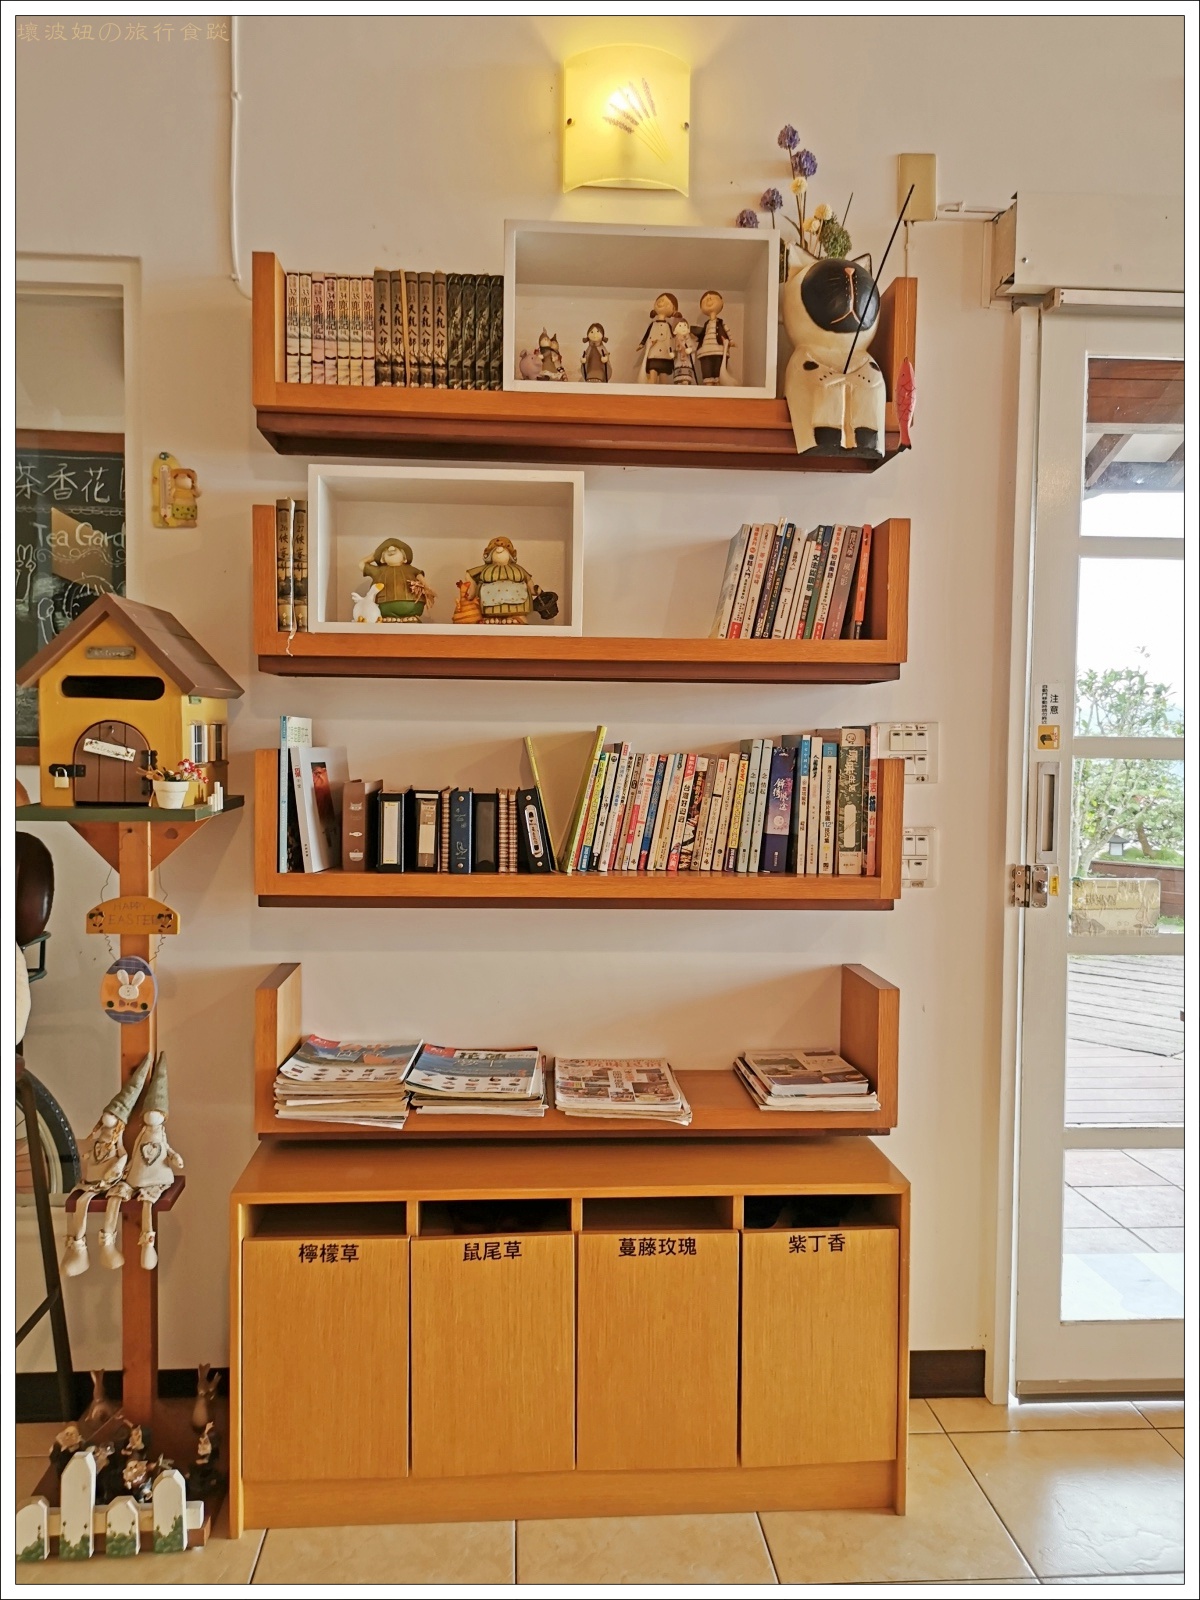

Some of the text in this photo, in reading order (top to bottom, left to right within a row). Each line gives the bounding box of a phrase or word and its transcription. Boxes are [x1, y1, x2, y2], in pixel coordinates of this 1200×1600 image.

[16, 462, 125, 502] 茶香花
[33, 522, 69, 547] Tea
[1050, 694, 1059, 715] 注意
[113, 902, 147, 911] HAPPY
[298, 1243, 359, 1263] 檸檬草
[463, 1240, 523, 1261] 鼠尾草
[618, 1237, 697, 1257] 蔓藤玫瑰
[788, 1233, 846, 1254] 紫丁香
